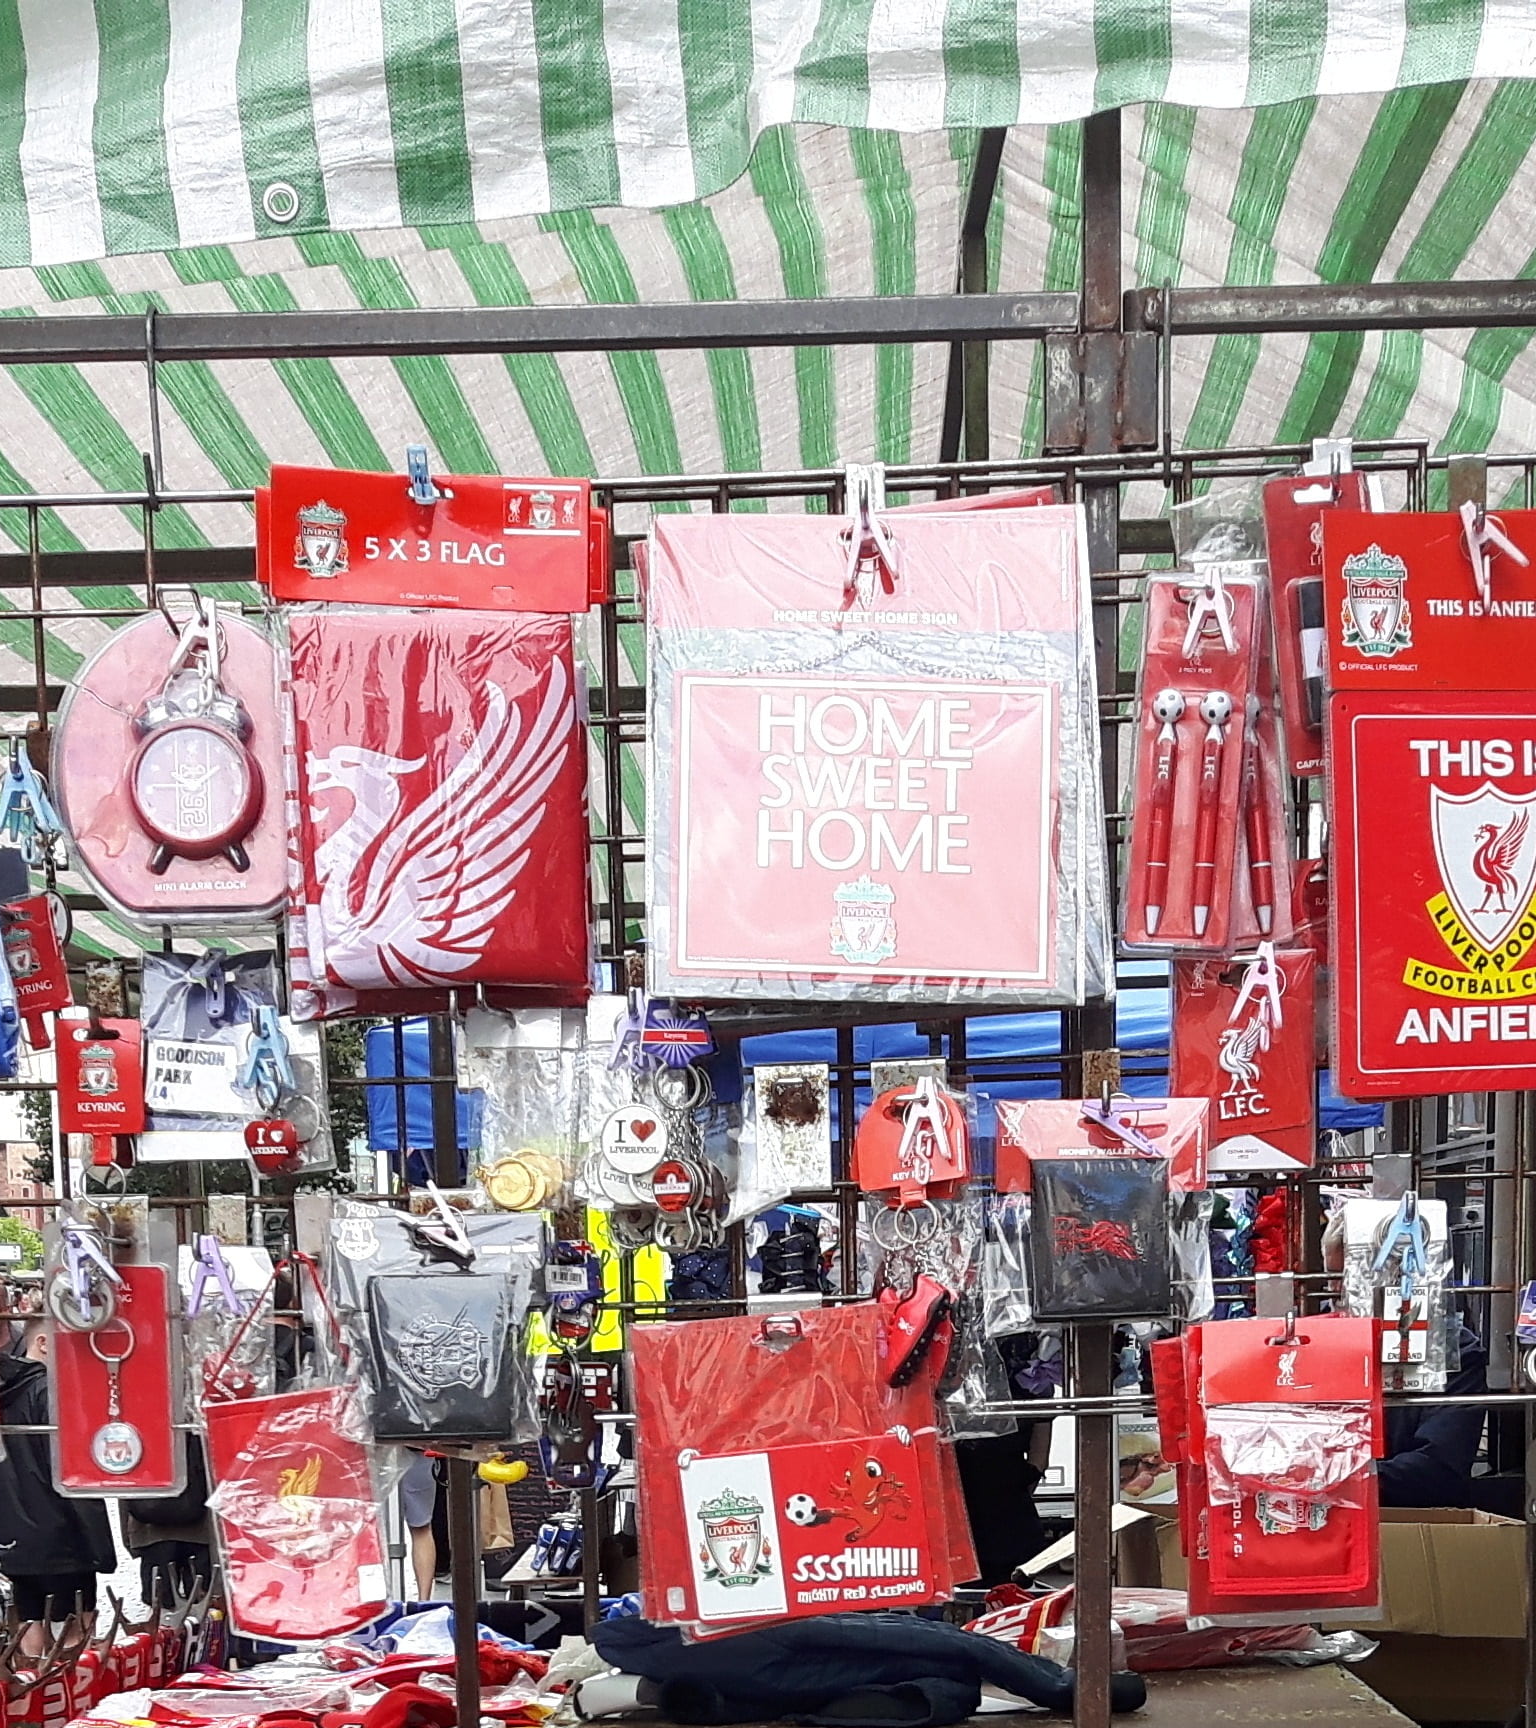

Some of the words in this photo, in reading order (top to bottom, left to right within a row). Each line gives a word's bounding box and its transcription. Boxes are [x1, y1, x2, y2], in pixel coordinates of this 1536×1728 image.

[366, 537, 378, 559] 5
[416, 541, 431, 561] 3
[441, 542, 505, 567] FLAG
[773, 611, 816, 623] HOME
[820, 612, 870, 623] SWEET
[875, 611, 918, 623] HOME
[923, 613, 958, 625] SIGN
[1427, 599, 1464, 616] THIS
[1468, 600, 1484, 616] IS
[759, 695, 972, 758] HOME
[1159, 756, 1169, 779] LFC
[1411, 740, 1508, 775] THIS
[762, 756, 971, 811] SWEET
[758, 810, 971, 874] HOME
[215, 879, 247, 890] CLOCK
[1412, 965, 1516, 993] FOOTBALL
[78, 1102, 125, 1113] KEYRING
[609, 1144, 659, 1154] LIVERPOOL
[1095, 1147, 1136, 1155] WALLET
[798, 1587, 839, 1603] MIGHTY
[844, 1586, 867, 1600] RED
[871, 1582, 924, 1598] SLEEPING
